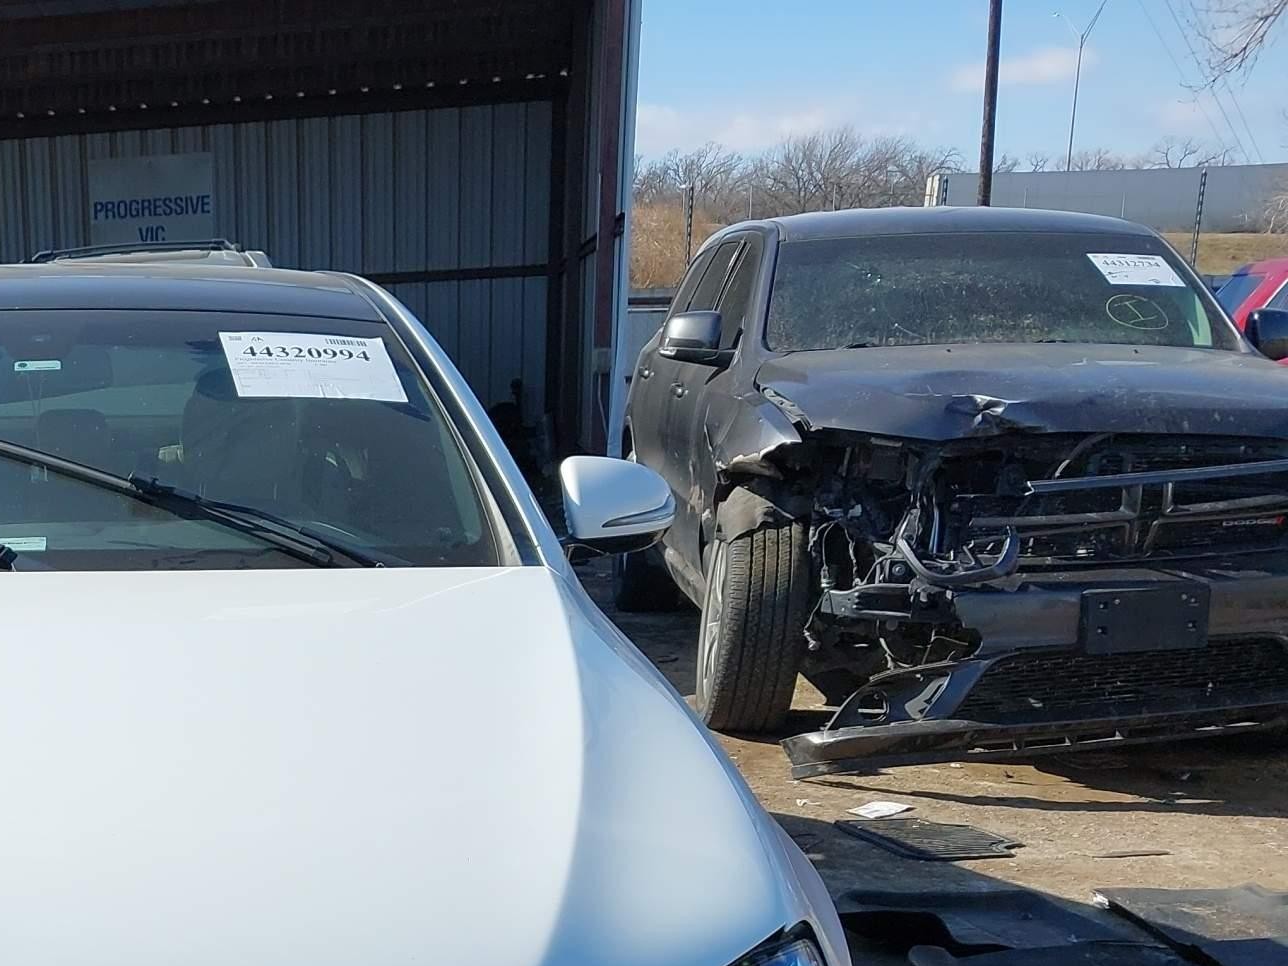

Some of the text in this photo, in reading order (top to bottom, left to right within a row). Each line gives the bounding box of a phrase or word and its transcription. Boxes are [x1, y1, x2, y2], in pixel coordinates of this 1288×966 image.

[93, 195, 211, 220] PROGRESSIVE
[1102, 259, 1161, 267] 44312734
[243, 345, 371, 362] 44320994
